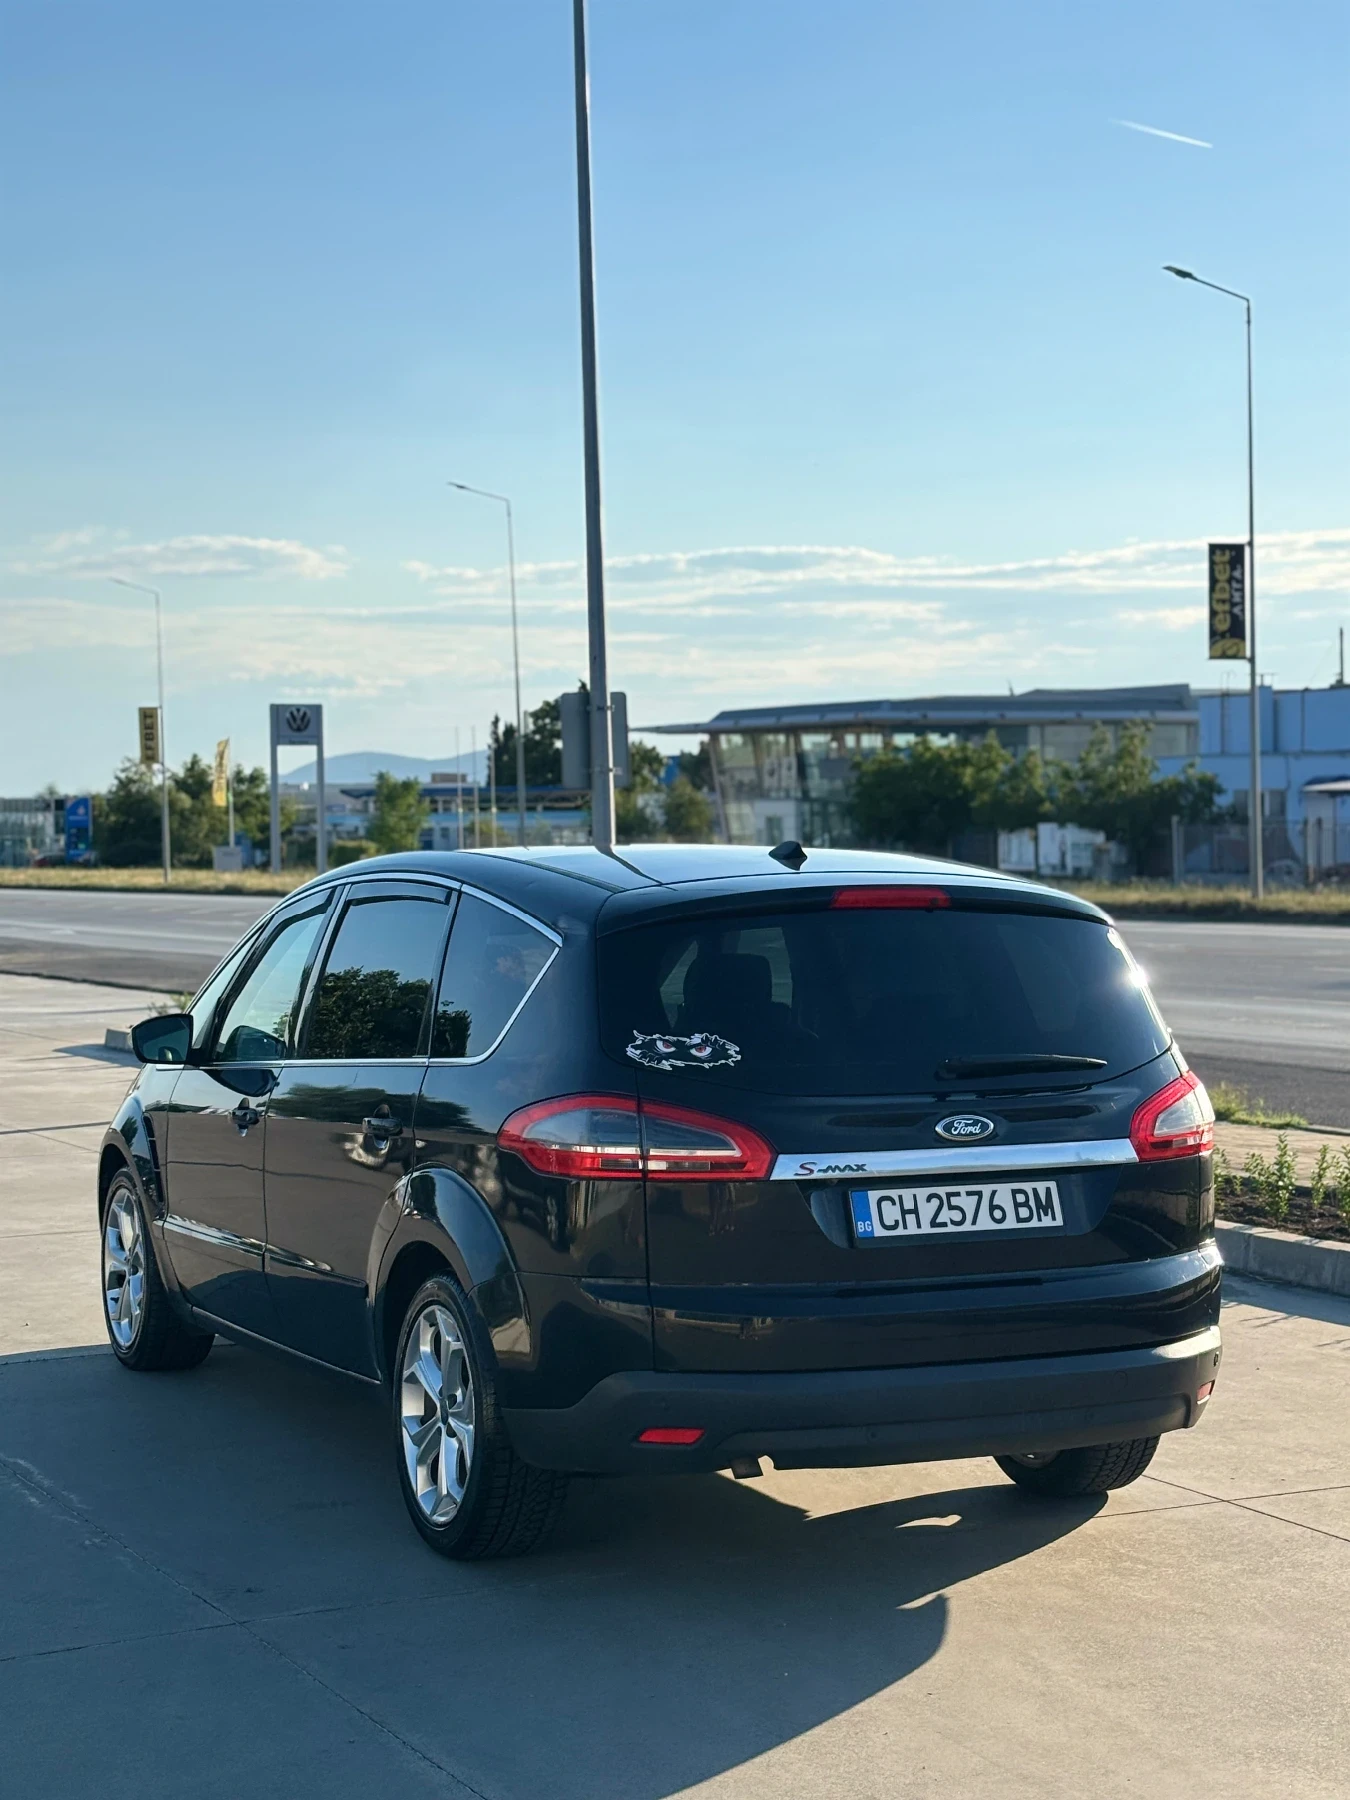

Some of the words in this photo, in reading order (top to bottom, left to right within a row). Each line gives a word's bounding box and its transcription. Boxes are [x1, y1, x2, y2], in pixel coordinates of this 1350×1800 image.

[1212, 549, 1231, 632] efbet
[951, 1119, 982, 1135] Ford
[793, 1161, 867, 1176] S-MAX
[857, 1221, 872, 1233] BG
